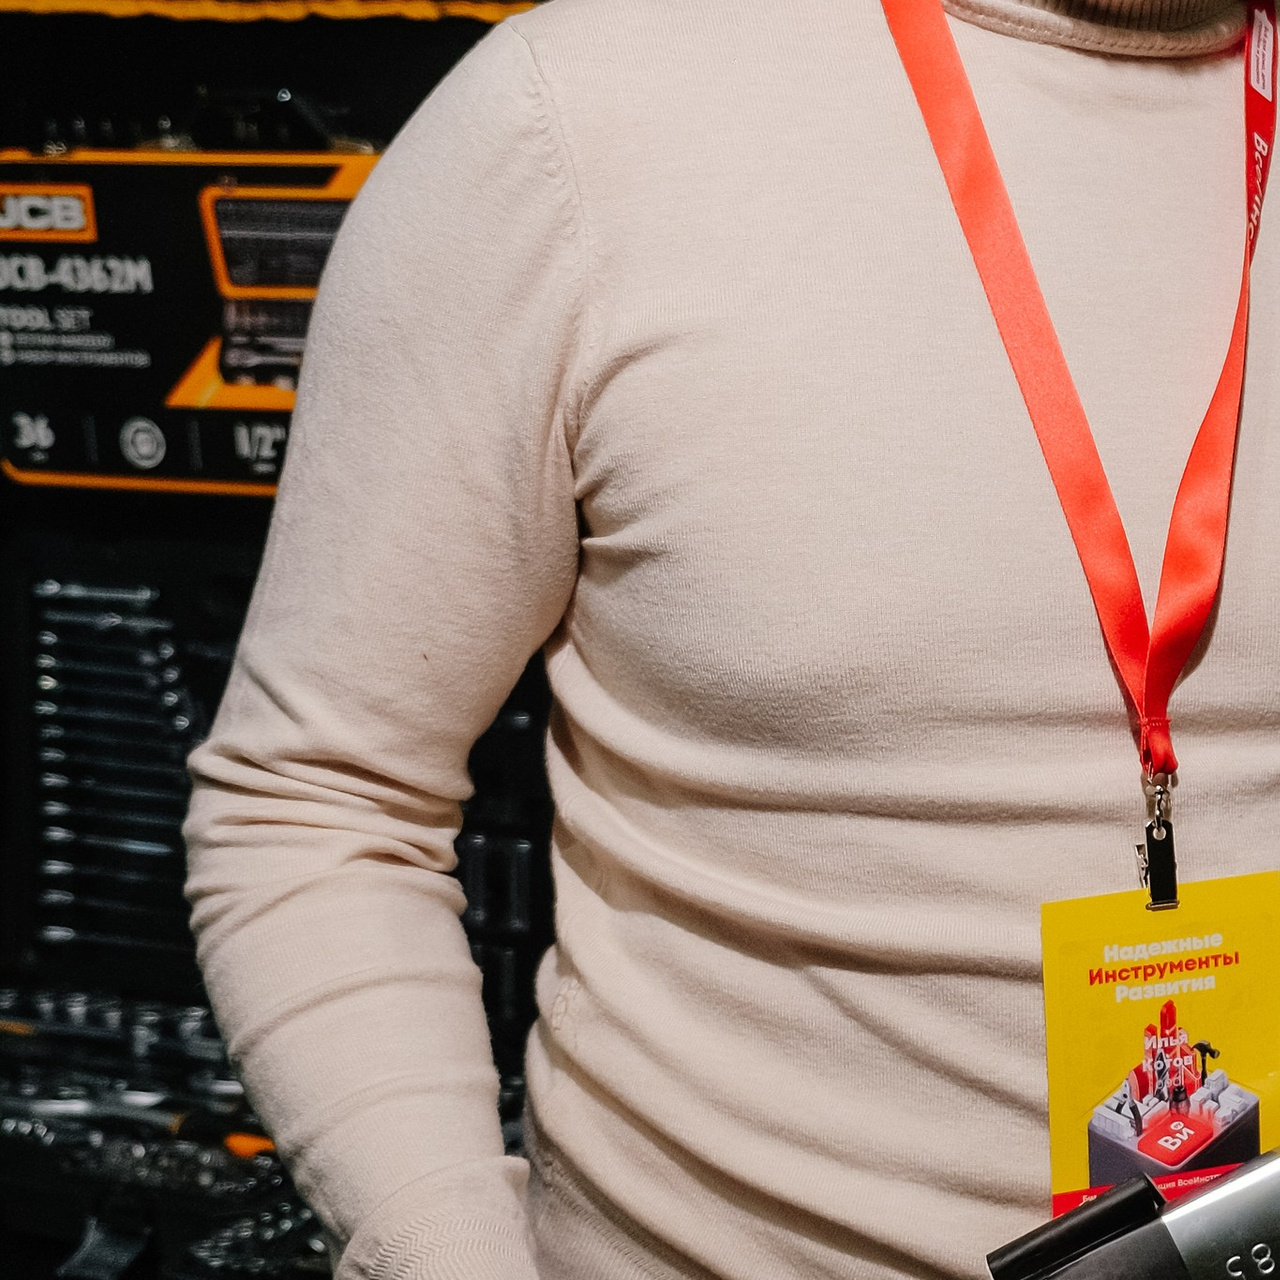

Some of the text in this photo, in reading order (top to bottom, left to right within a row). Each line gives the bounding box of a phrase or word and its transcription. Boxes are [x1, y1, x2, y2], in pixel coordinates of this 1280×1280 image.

[1103, 932, 1223, 963] Надежные
[1089, 952, 1240, 986] Инструменты
[1115, 975, 1216, 1003] Развития
